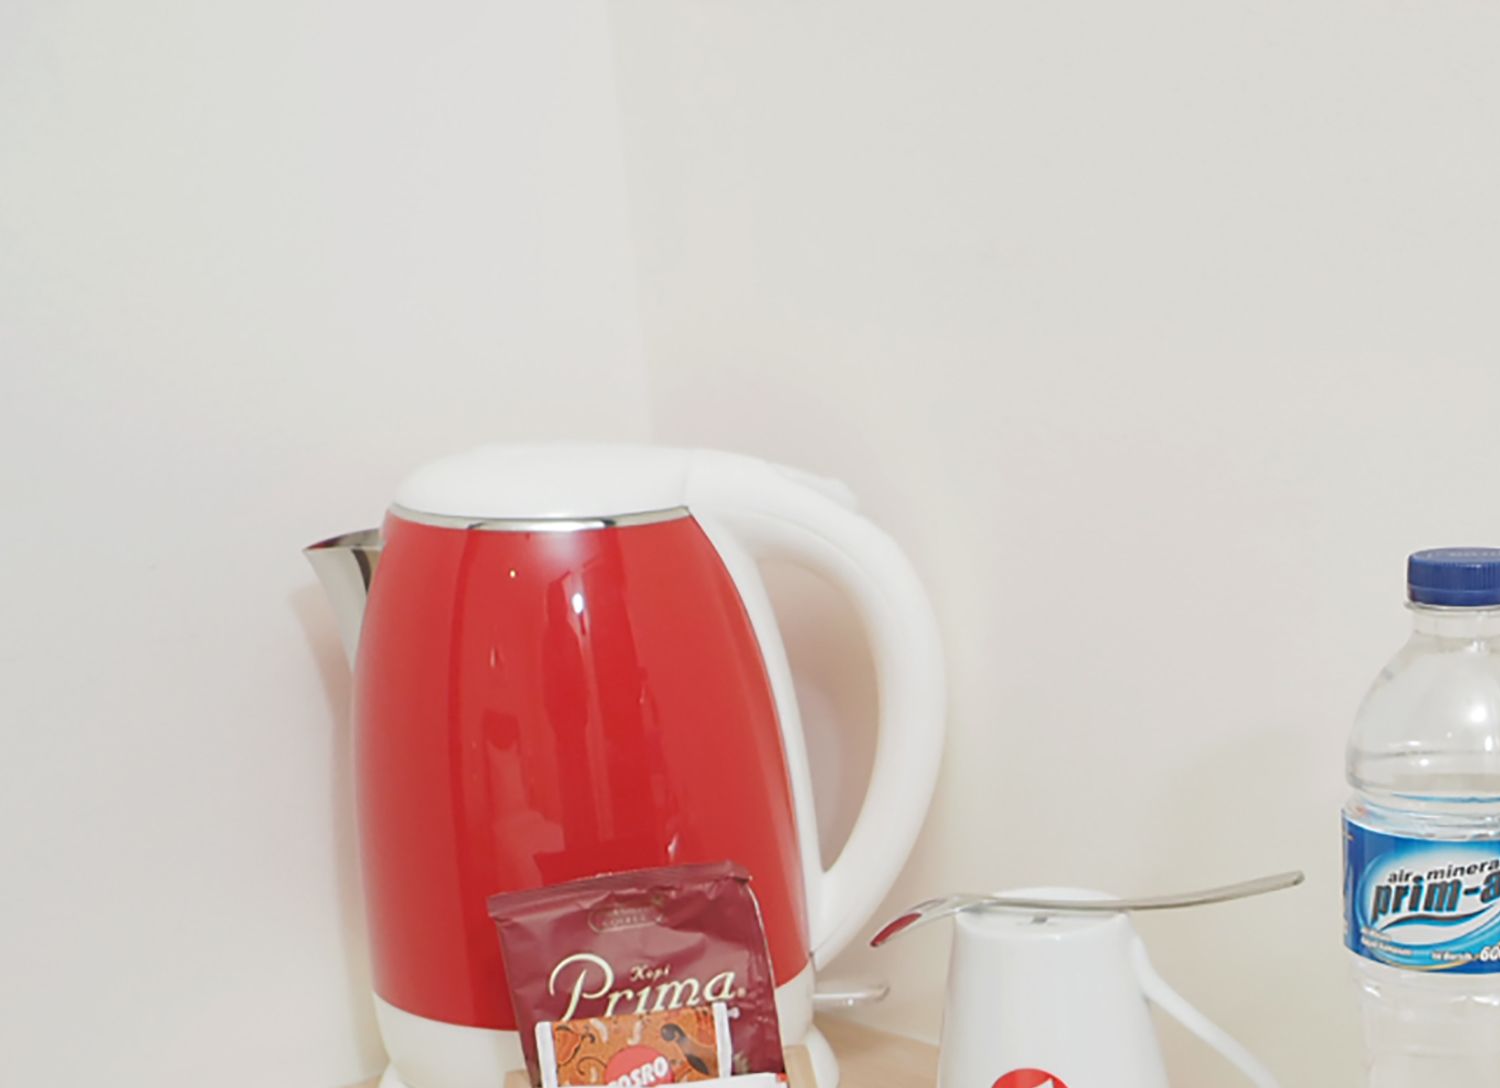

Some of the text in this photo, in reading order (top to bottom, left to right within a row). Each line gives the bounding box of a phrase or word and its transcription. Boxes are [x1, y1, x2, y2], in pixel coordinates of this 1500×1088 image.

[1387, 868, 1413, 883] air
[629, 962, 672, 984] Kopi
[549, 953, 738, 1022] Prima
